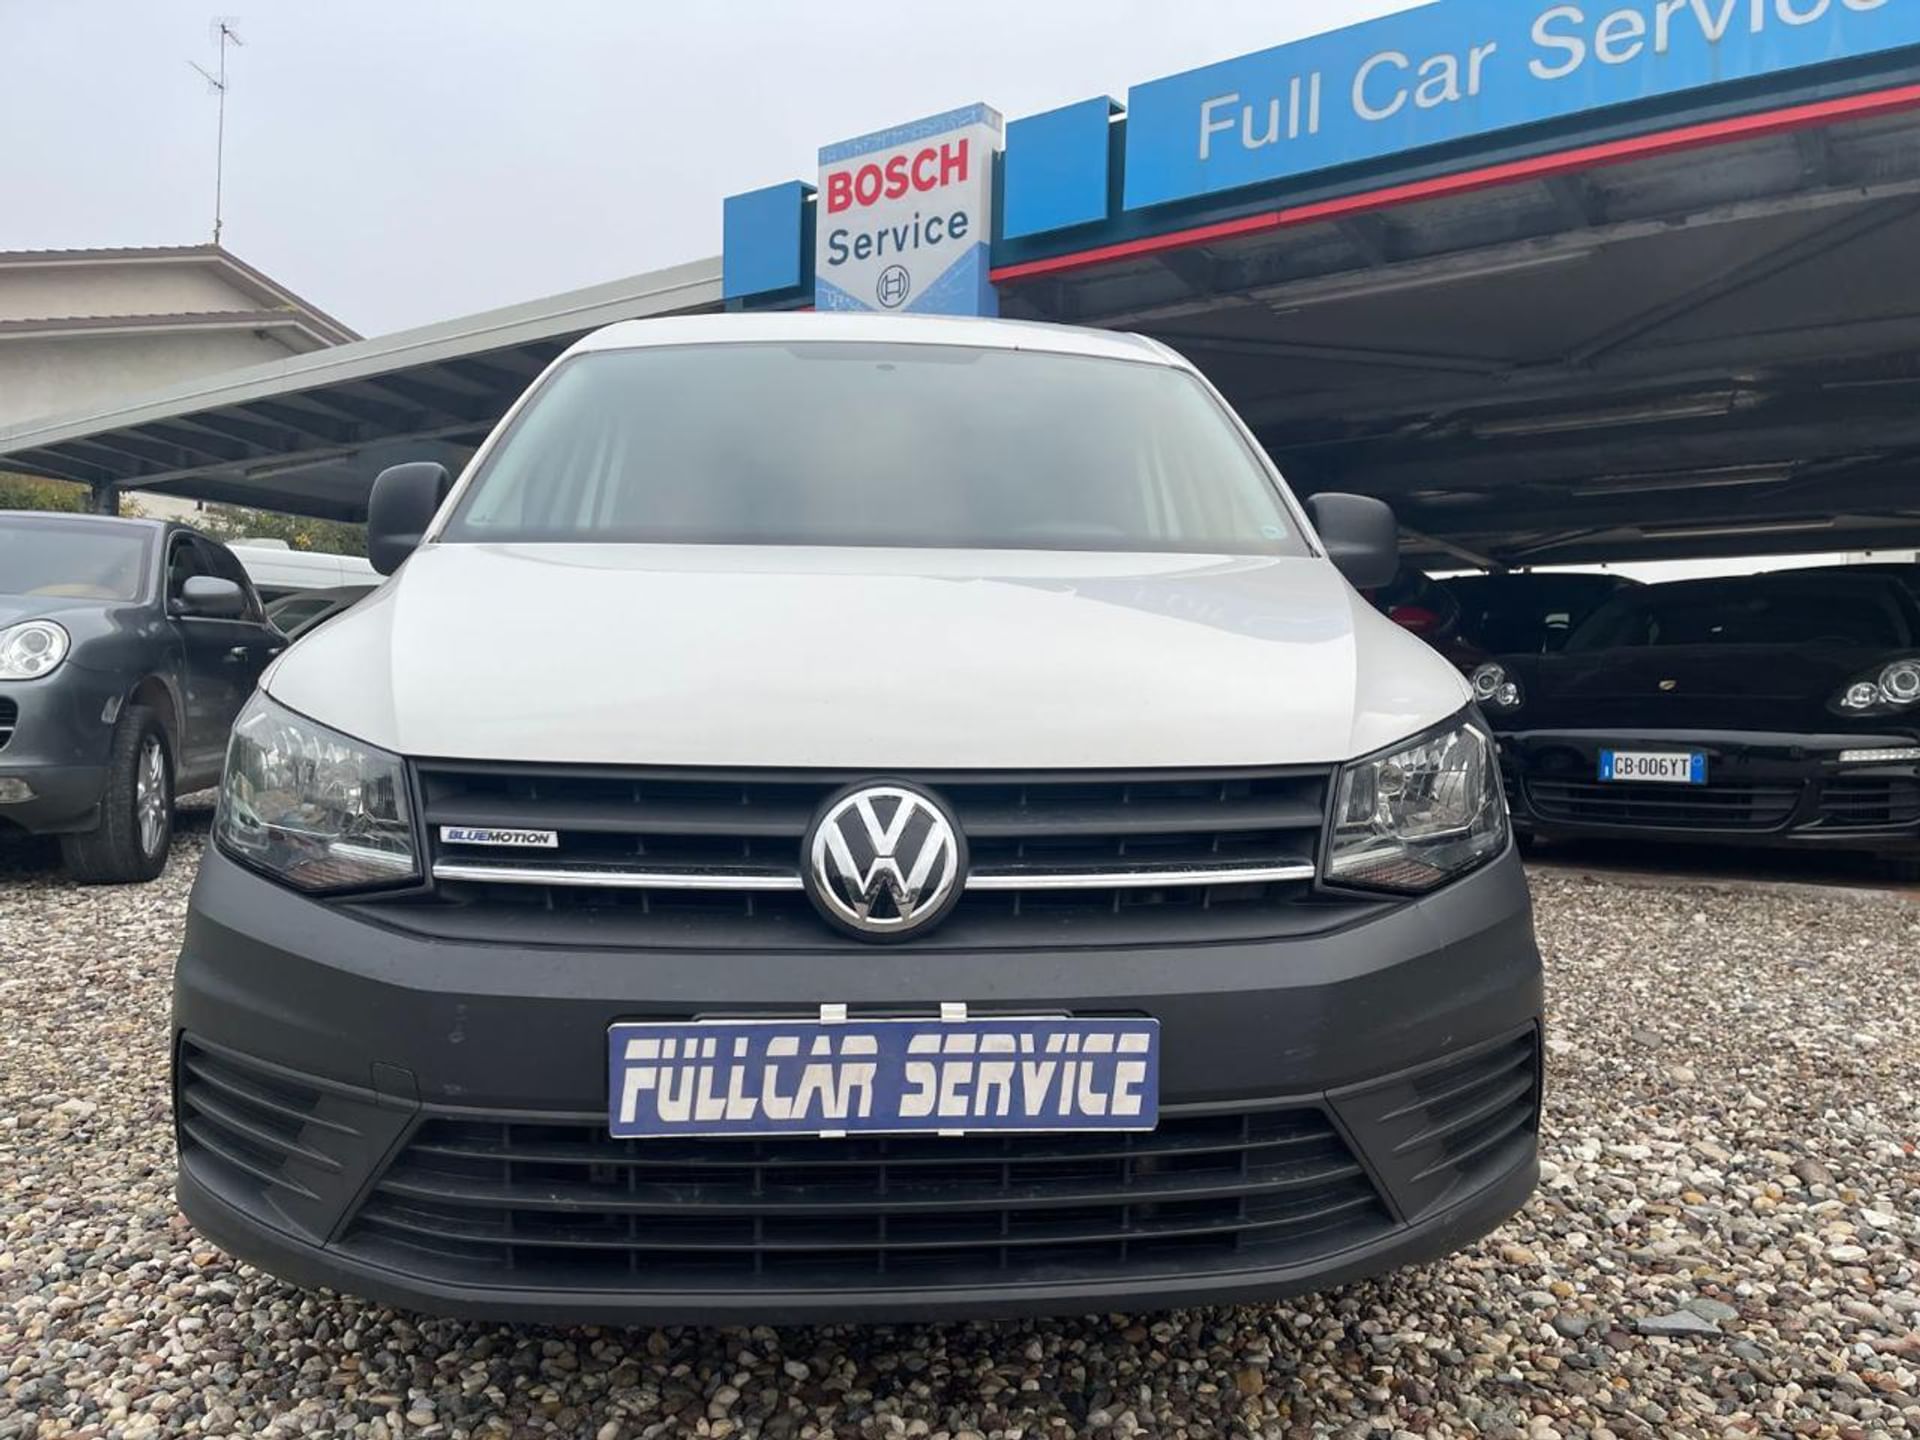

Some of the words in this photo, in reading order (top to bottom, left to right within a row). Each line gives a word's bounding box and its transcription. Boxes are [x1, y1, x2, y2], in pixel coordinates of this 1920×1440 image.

[1200, 72, 1320, 160] Full
[1351, 40, 1496, 122] Car
[1529, 0, 1889, 80] Serv
[827, 139, 969, 214] BOSCH
[827, 211, 969, 266] Service
[448, 829, 549, 844] BLUEMOTION
[899, 1033, 1150, 1117] SERVICE
